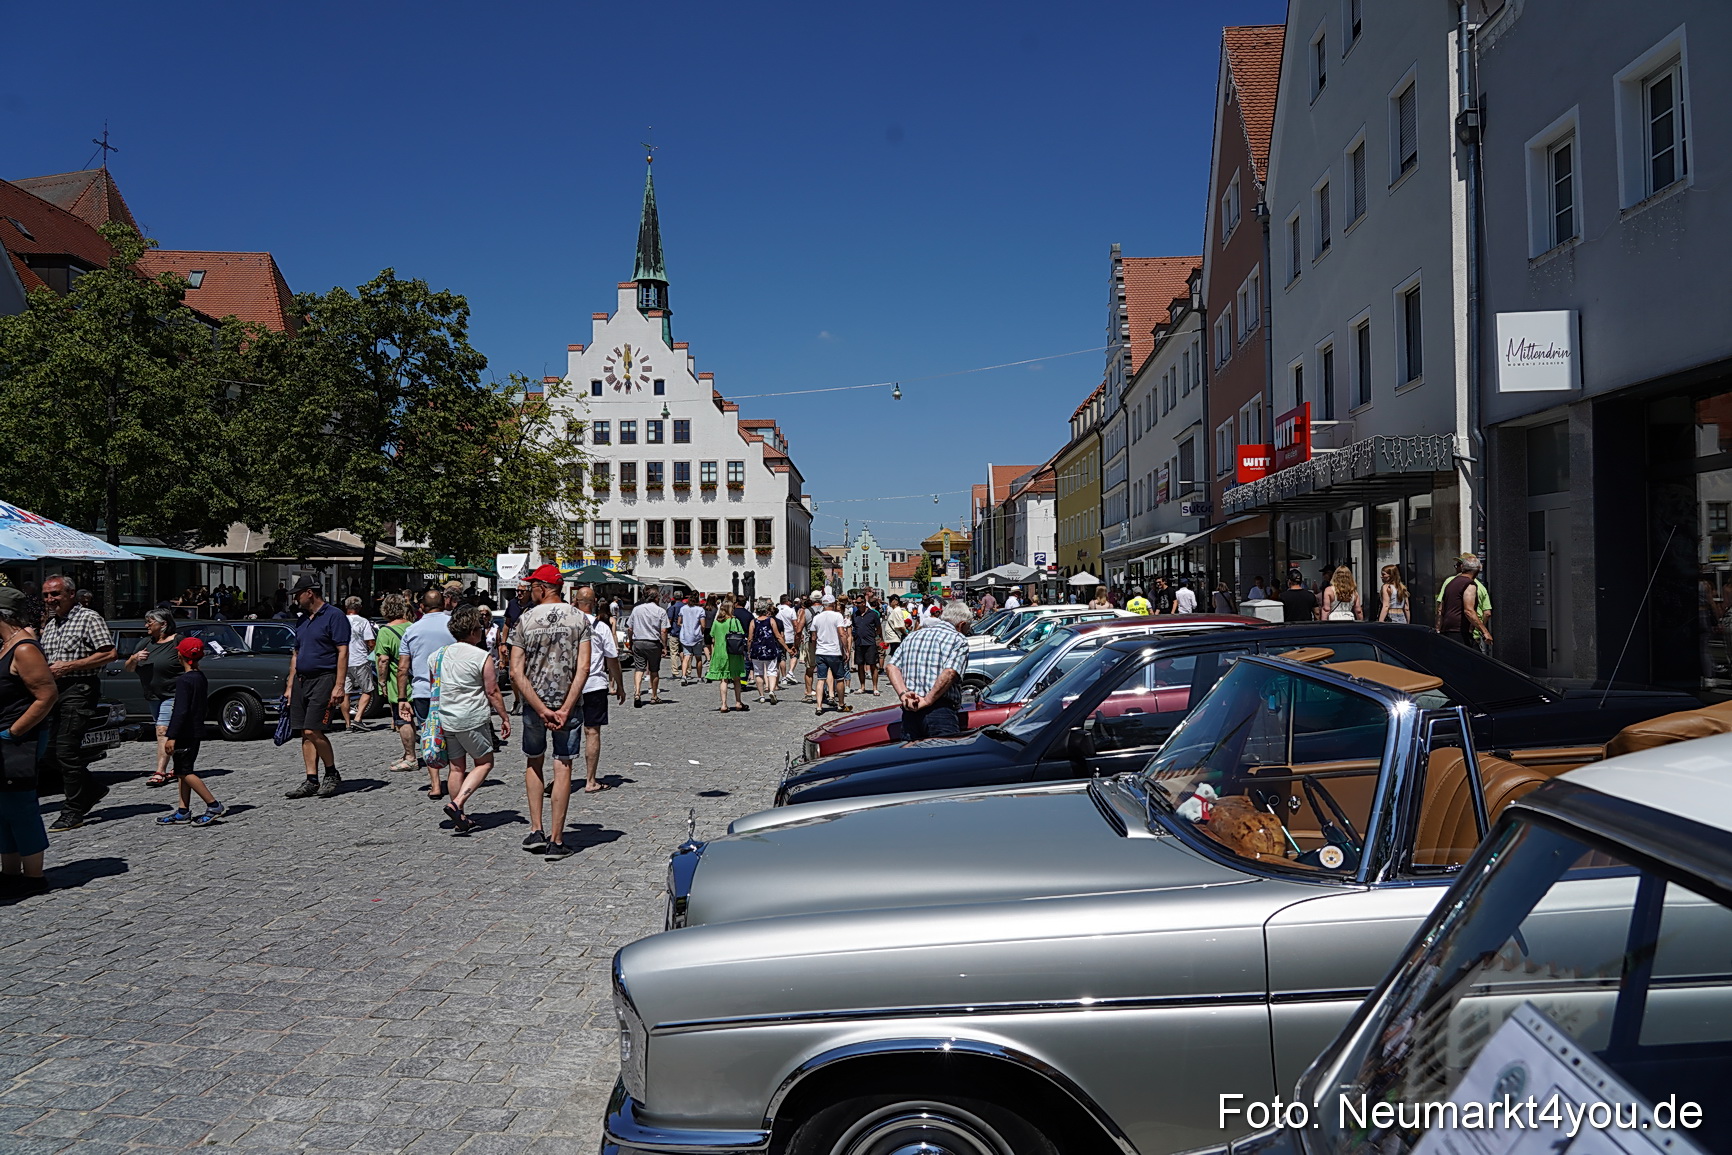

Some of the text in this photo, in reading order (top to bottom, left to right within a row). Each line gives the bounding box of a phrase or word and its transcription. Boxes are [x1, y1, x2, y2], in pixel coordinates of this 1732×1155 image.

[1506, 338, 1571, 362] Mittendrin
[1243, 457, 1271, 467] WITT
[1034, 553, 1046, 564] R
